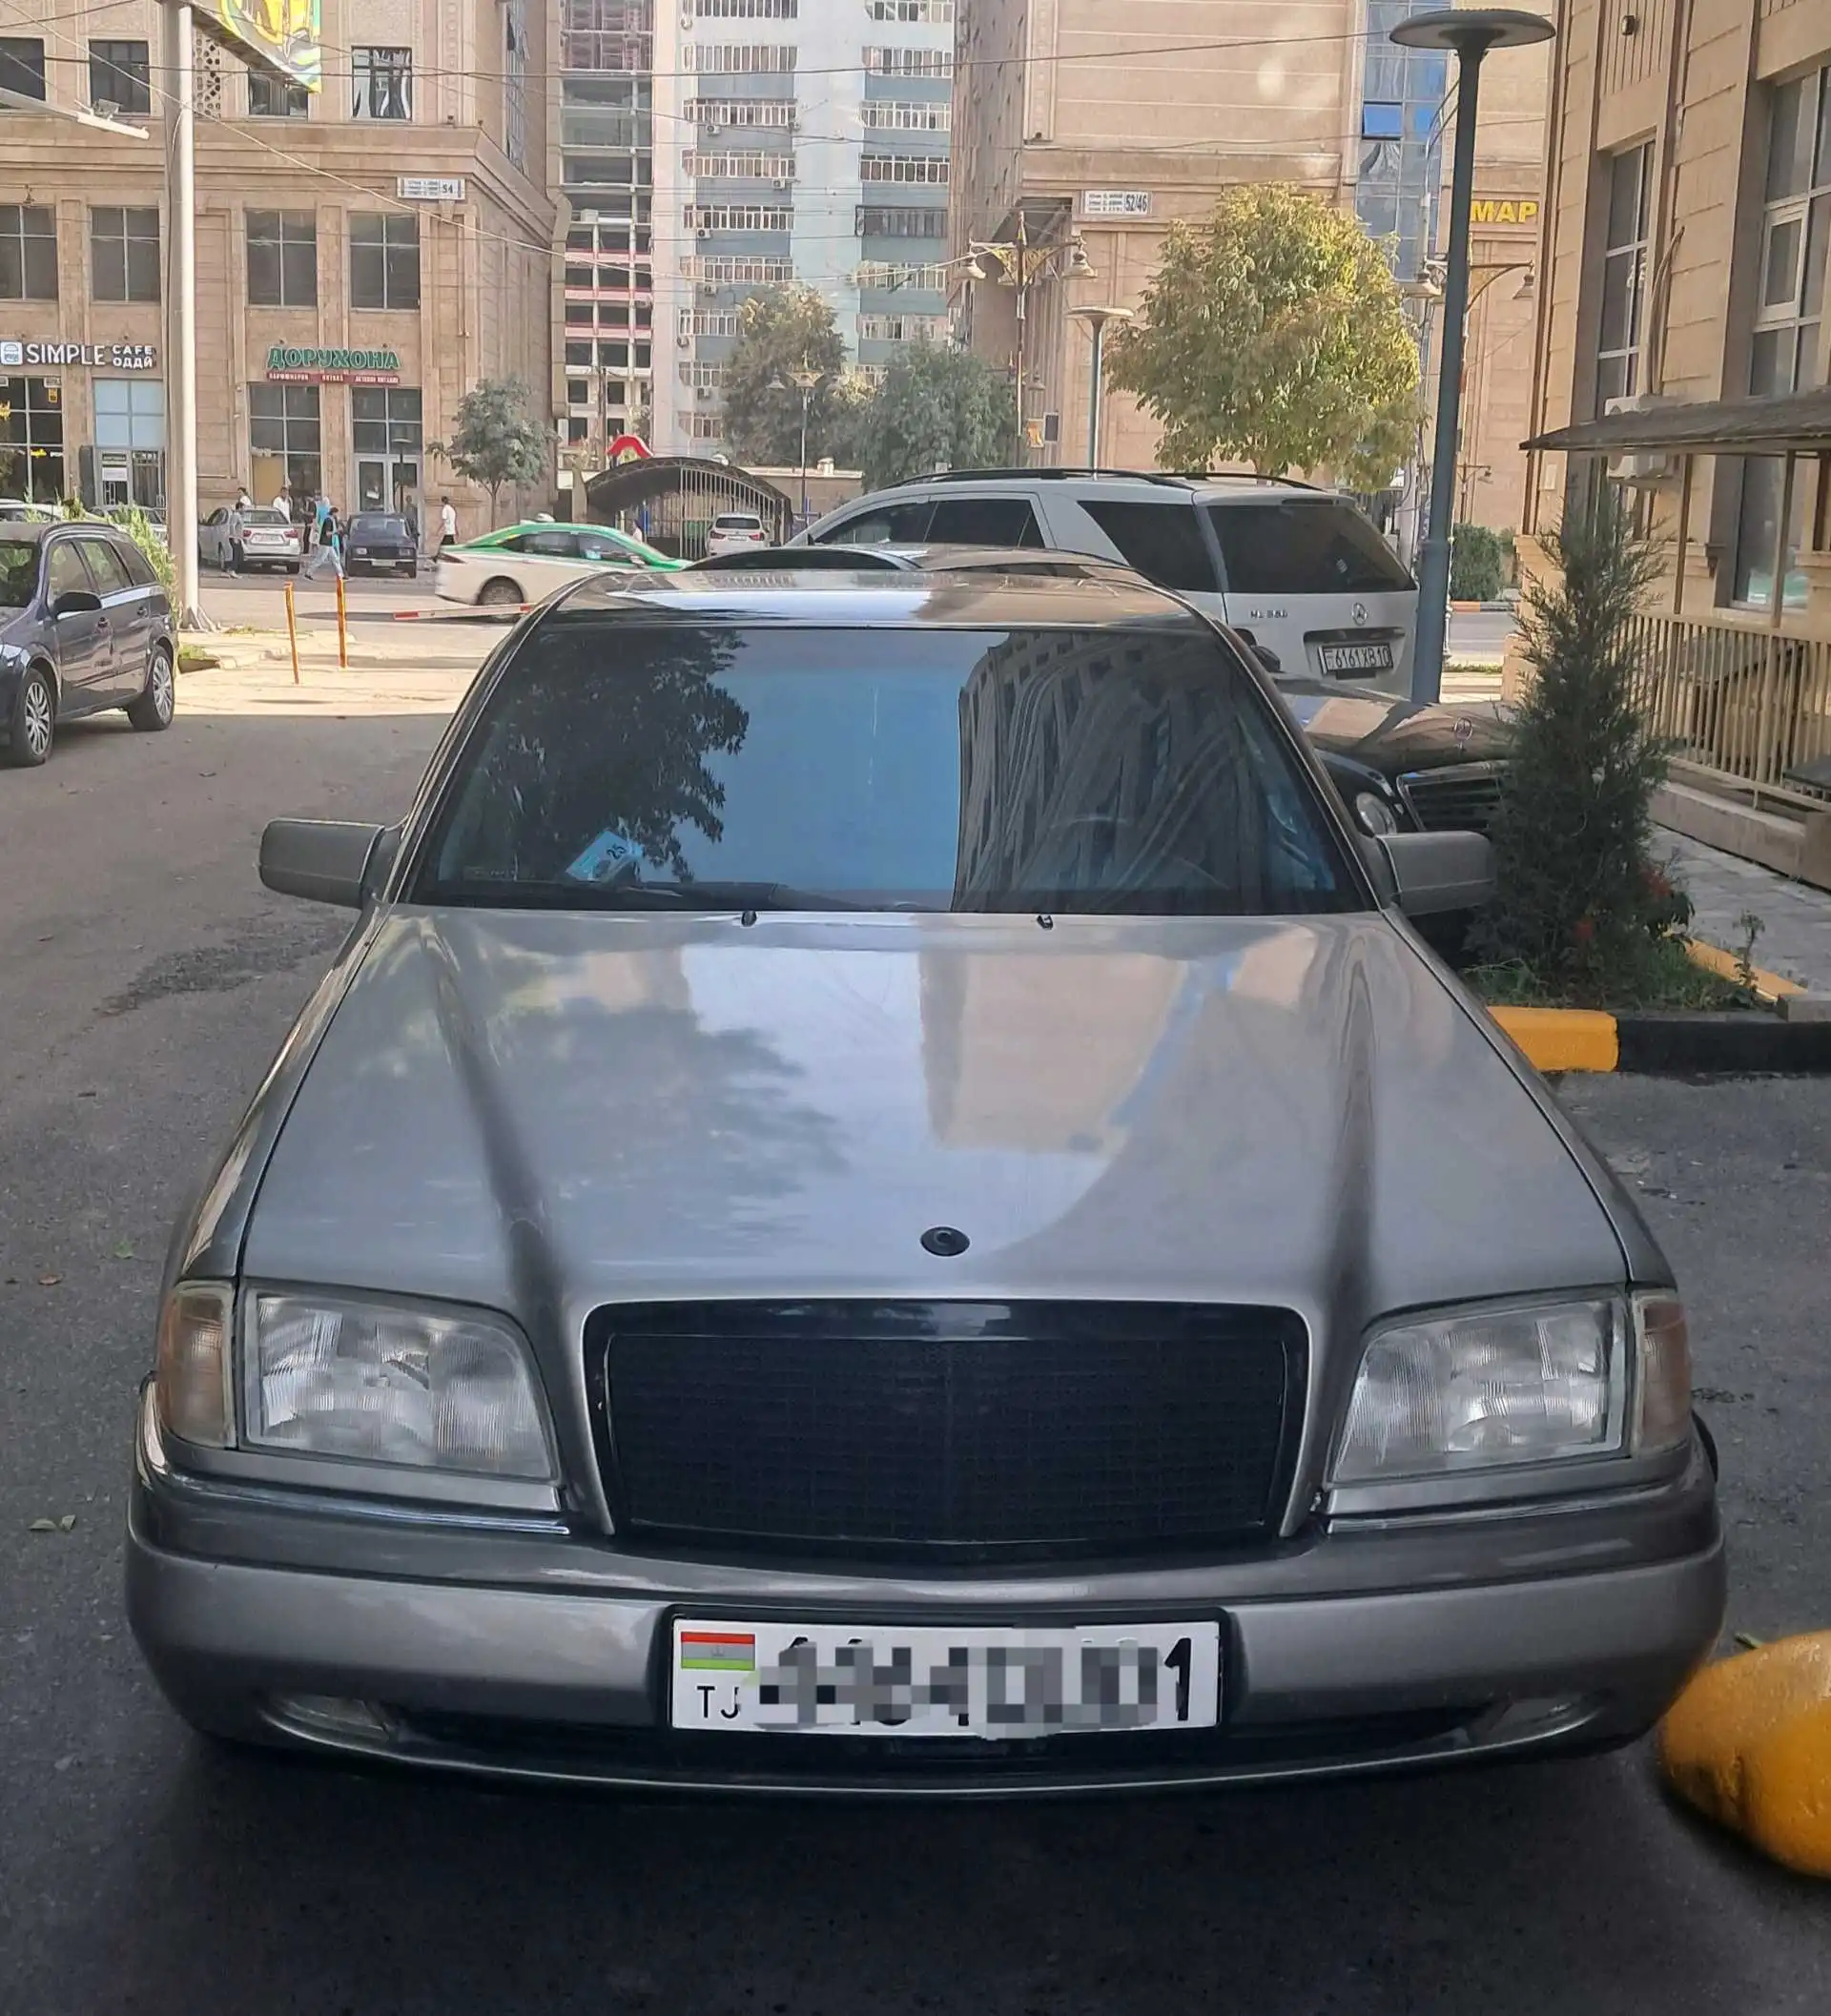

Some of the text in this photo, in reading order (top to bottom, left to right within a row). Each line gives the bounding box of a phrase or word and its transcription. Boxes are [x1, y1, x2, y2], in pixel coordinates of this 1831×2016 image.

[1125, 194, 1147, 213] 52/46
[26, 343, 154, 365] SIMPLE CAFE
[267, 346, 401, 370] ДОРУХОНА
